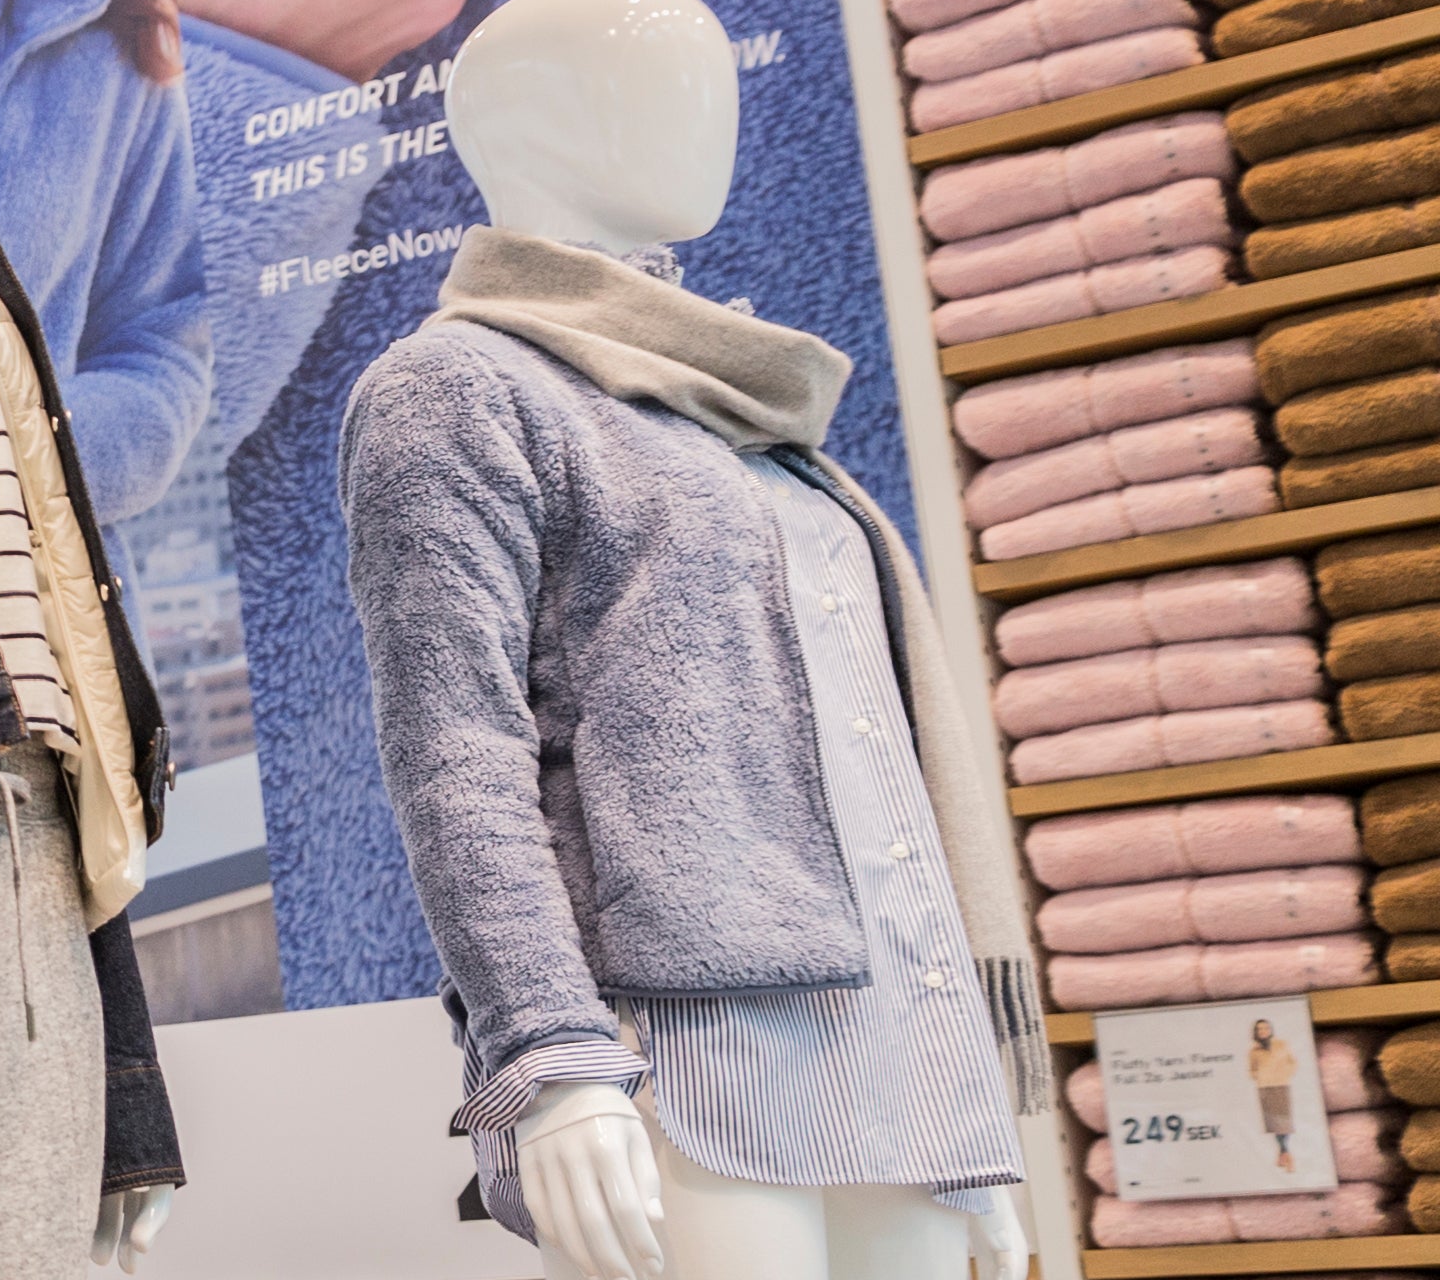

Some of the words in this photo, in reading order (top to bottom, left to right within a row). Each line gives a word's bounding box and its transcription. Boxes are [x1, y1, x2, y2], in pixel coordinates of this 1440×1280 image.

[245, 72, 407, 145] COMFORT
[251, 155, 326, 201] THIS
[335, 143, 369, 179] IS
[378, 120, 448, 167] THE
[258, 224, 463, 297] #FleeceNow
[1122, 1114, 1184, 1144] 249
[1187, 1126, 1221, 1141] SEK
